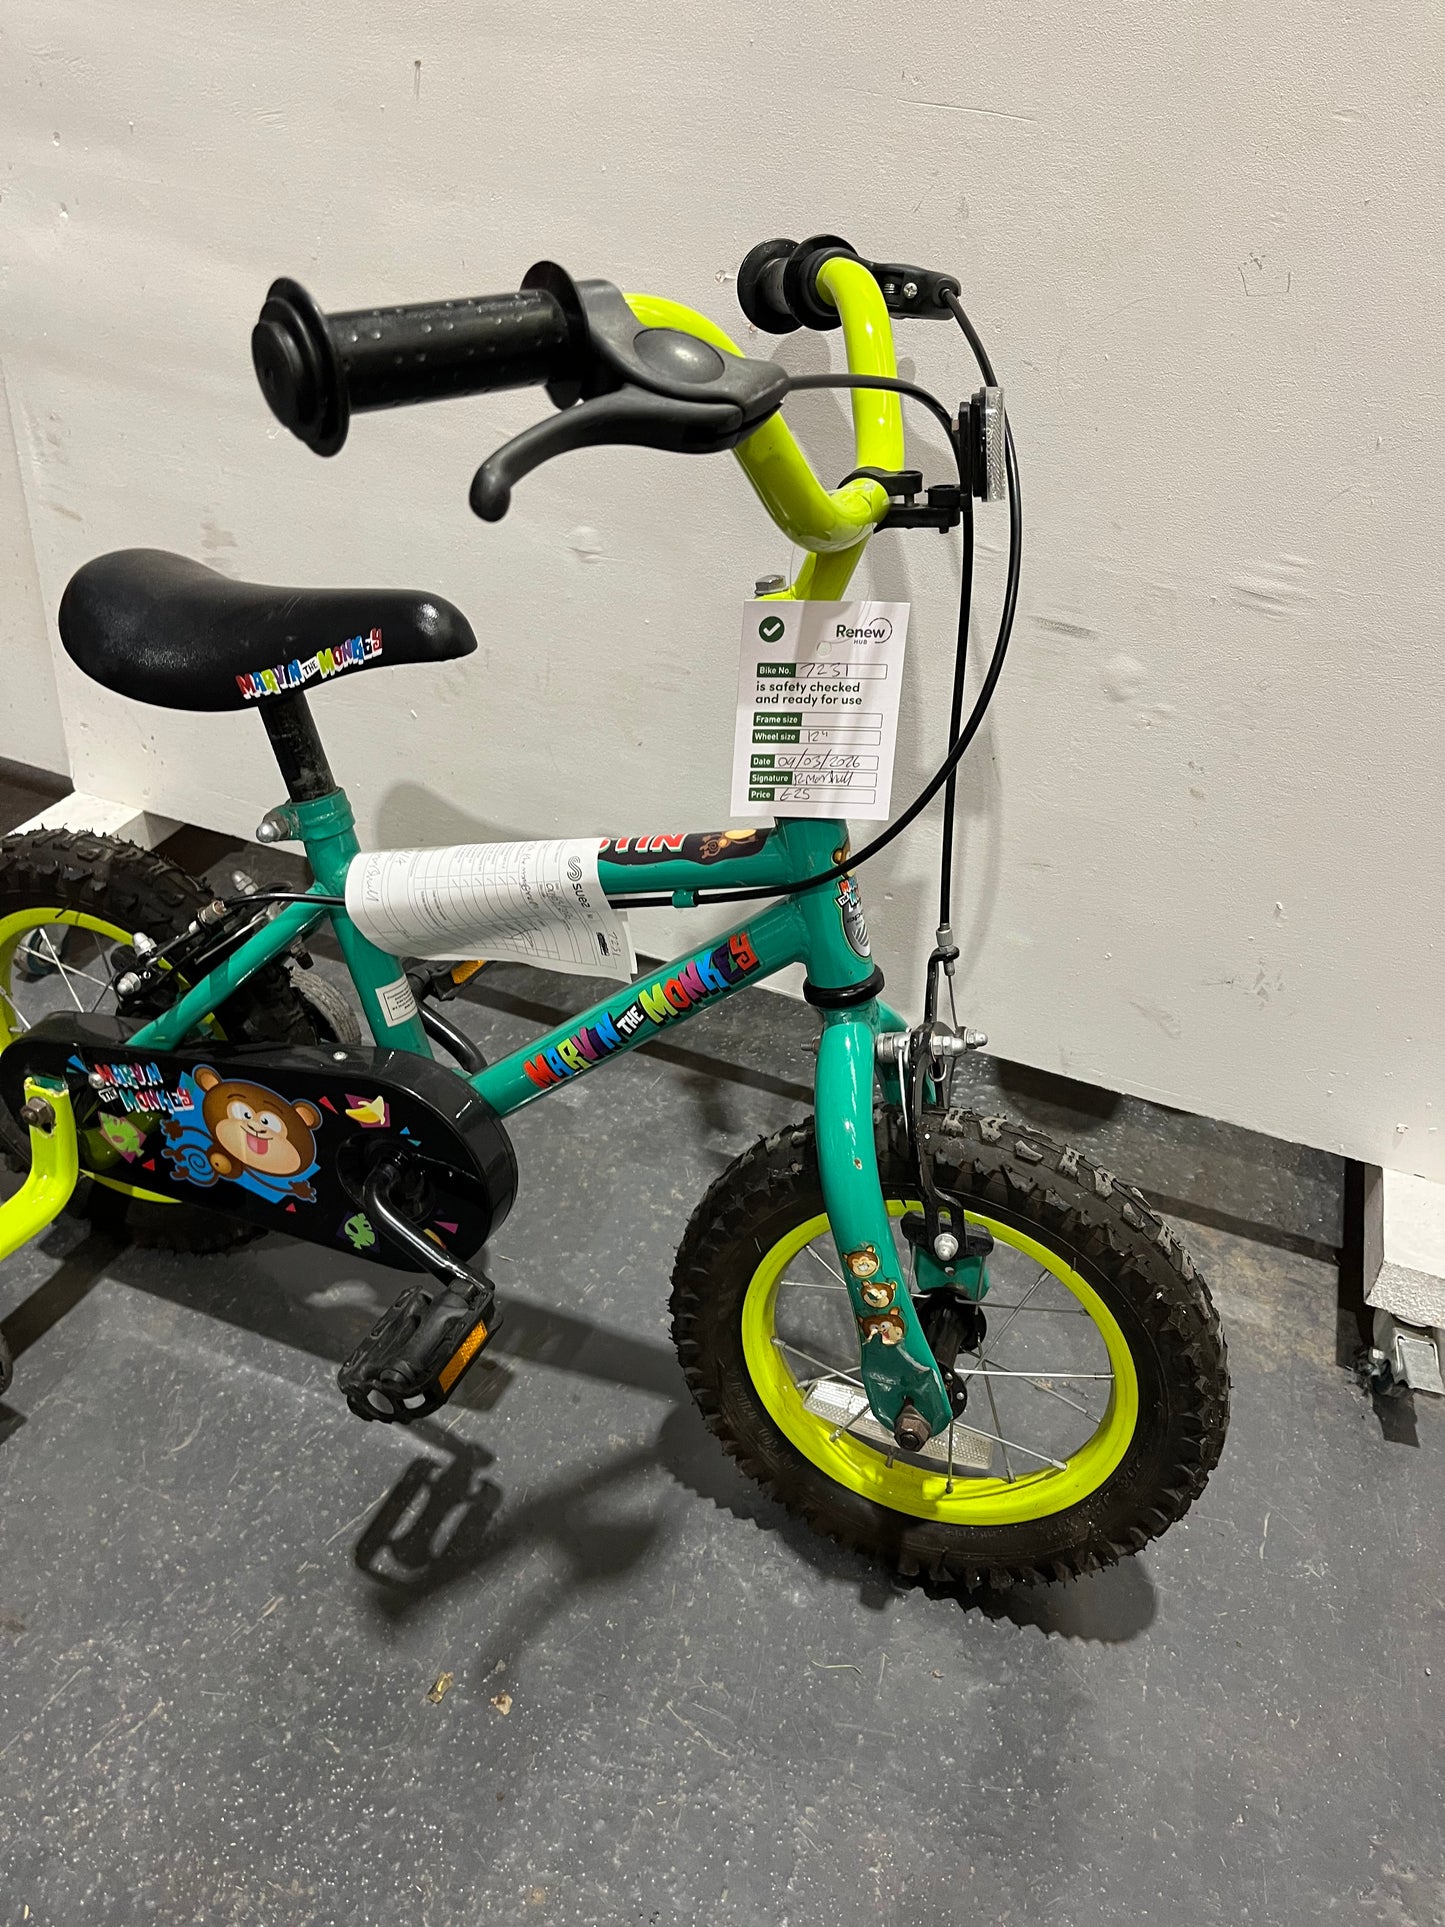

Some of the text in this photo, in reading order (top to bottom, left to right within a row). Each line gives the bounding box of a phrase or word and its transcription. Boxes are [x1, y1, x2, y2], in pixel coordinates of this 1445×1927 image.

[836, 624, 885, 638] Renew
[235, 628, 383, 699] MARVIN THE MONKEY
[759, 663, 849, 678] Bike No. 7231
[756, 681, 860, 694] is safety checked
[755, 694, 862, 707] and ready for use
[756, 715, 798, 723] Frame size
[754, 732, 779, 741] Wheel
[781, 732, 796, 741] size
[753, 757, 771, 765] Date
[752, 774, 789, 784] Signature
[572, 883, 590, 909] suez
[523, 932, 761, 1089] MARVIN THE MONKEY
[119, 1087, 195, 1115] MONKEY
